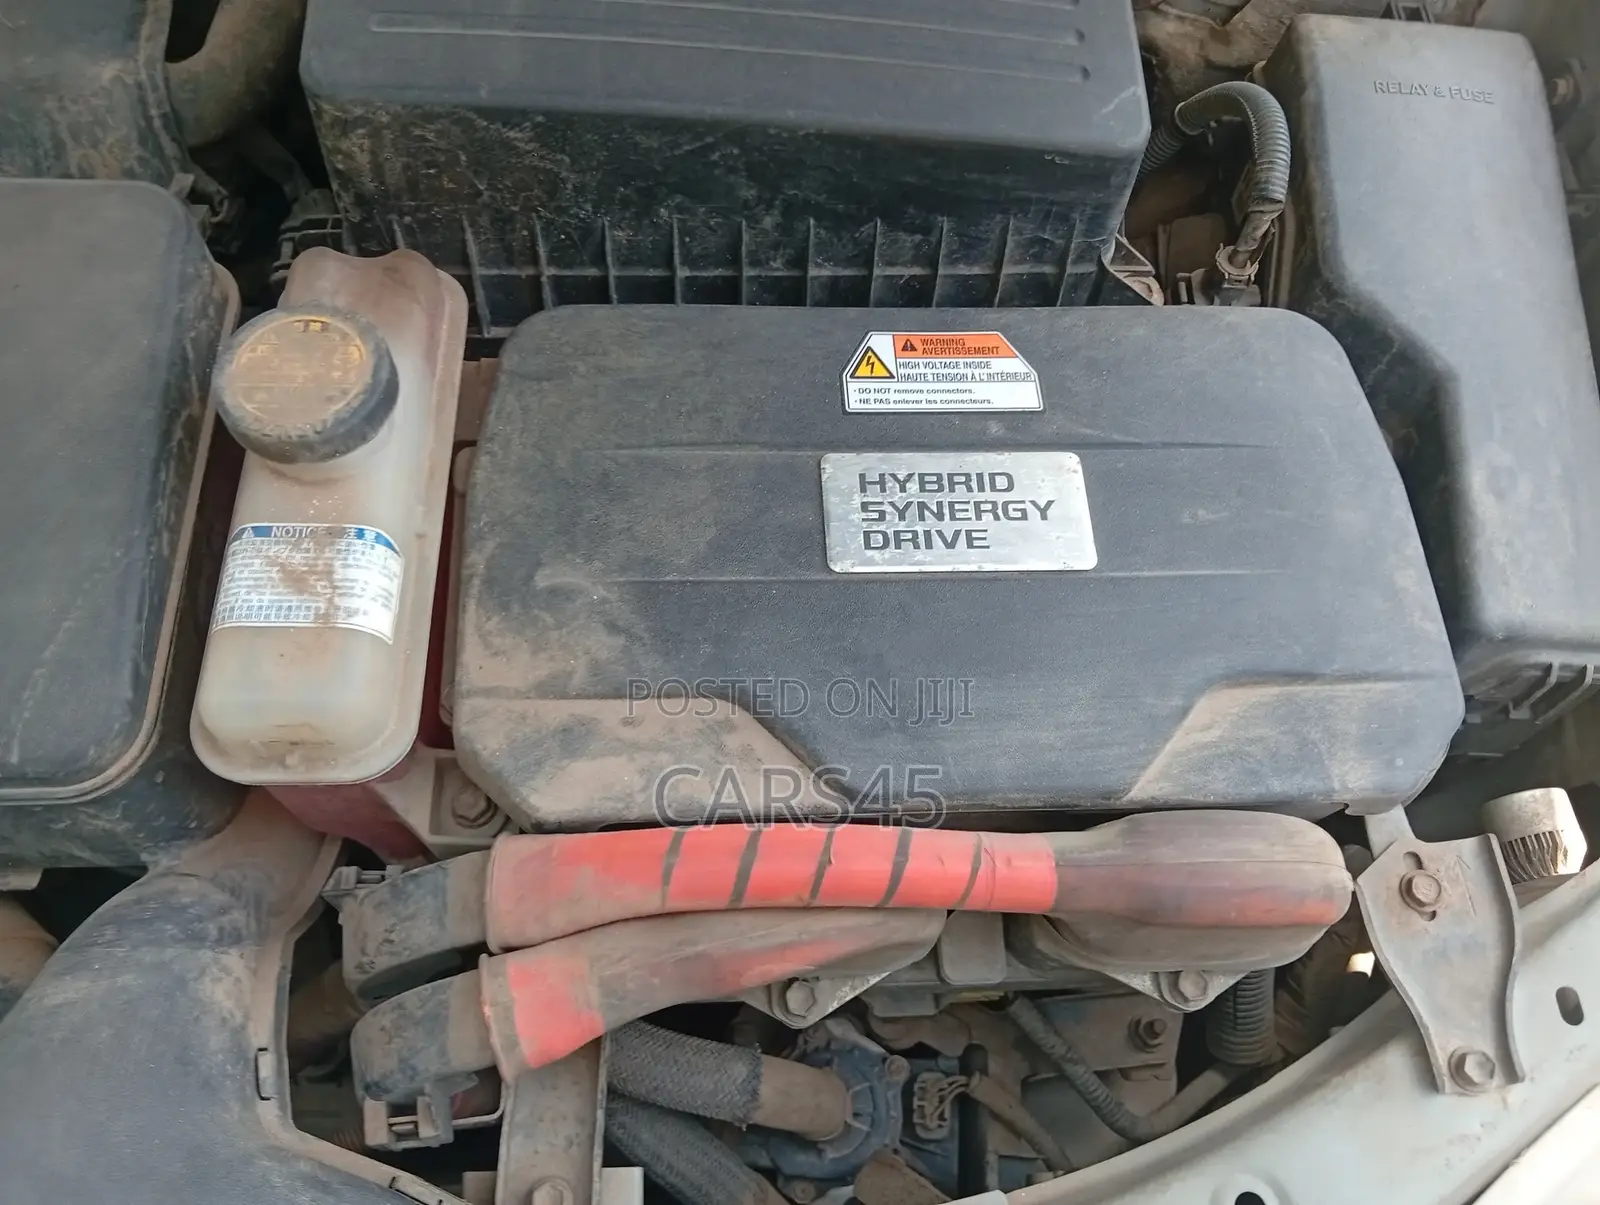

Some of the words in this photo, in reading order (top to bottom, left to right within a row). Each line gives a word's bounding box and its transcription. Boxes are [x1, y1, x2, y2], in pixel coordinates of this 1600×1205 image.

[1373, 80, 1428, 96] RELAY
[1433, 85, 1446, 98] &
[1449, 86, 1495, 104] FUSE
[920, 338, 966, 347] WARNING
[921, 346, 1000, 356] AVERTISSEMENT
[898, 361, 920, 370] HIGH
[922, 360, 962, 370] VOLTAGE
[963, 360, 992, 370] INSIDE
[900, 372, 929, 381] HAUTE
[930, 372, 969, 381] TENSION
[858, 472, 1015, 493] HYBRID
[861, 499, 1056, 522] SYNERGY
[862, 529, 991, 550] DRIVE
